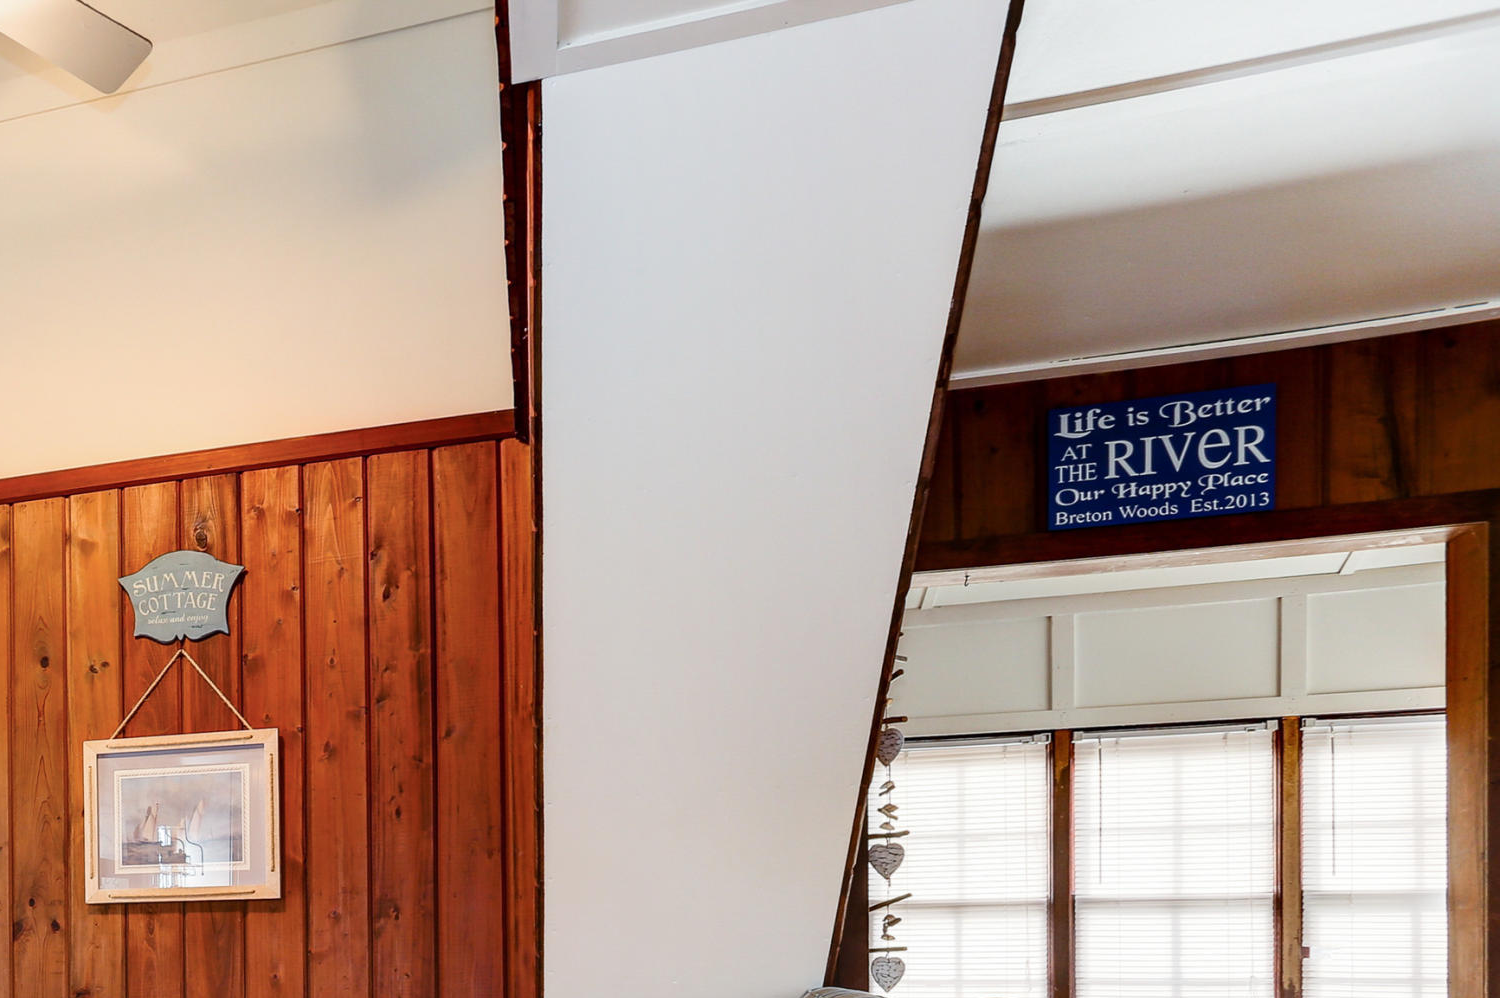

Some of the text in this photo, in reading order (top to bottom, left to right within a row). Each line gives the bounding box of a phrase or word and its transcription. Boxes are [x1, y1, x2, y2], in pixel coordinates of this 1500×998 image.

[1053, 396, 1272, 439] Life is Better
[1061, 443, 1093, 462] AT
[1054, 462, 1098, 484] THE
[1055, 472, 1269, 507] Our Happy Place
[1055, 510, 1113, 526] Breton
[1119, 502, 1179, 519] Woods
[132, 570, 226, 598] SUMMER
[138, 591, 219, 616] COTTAGE
